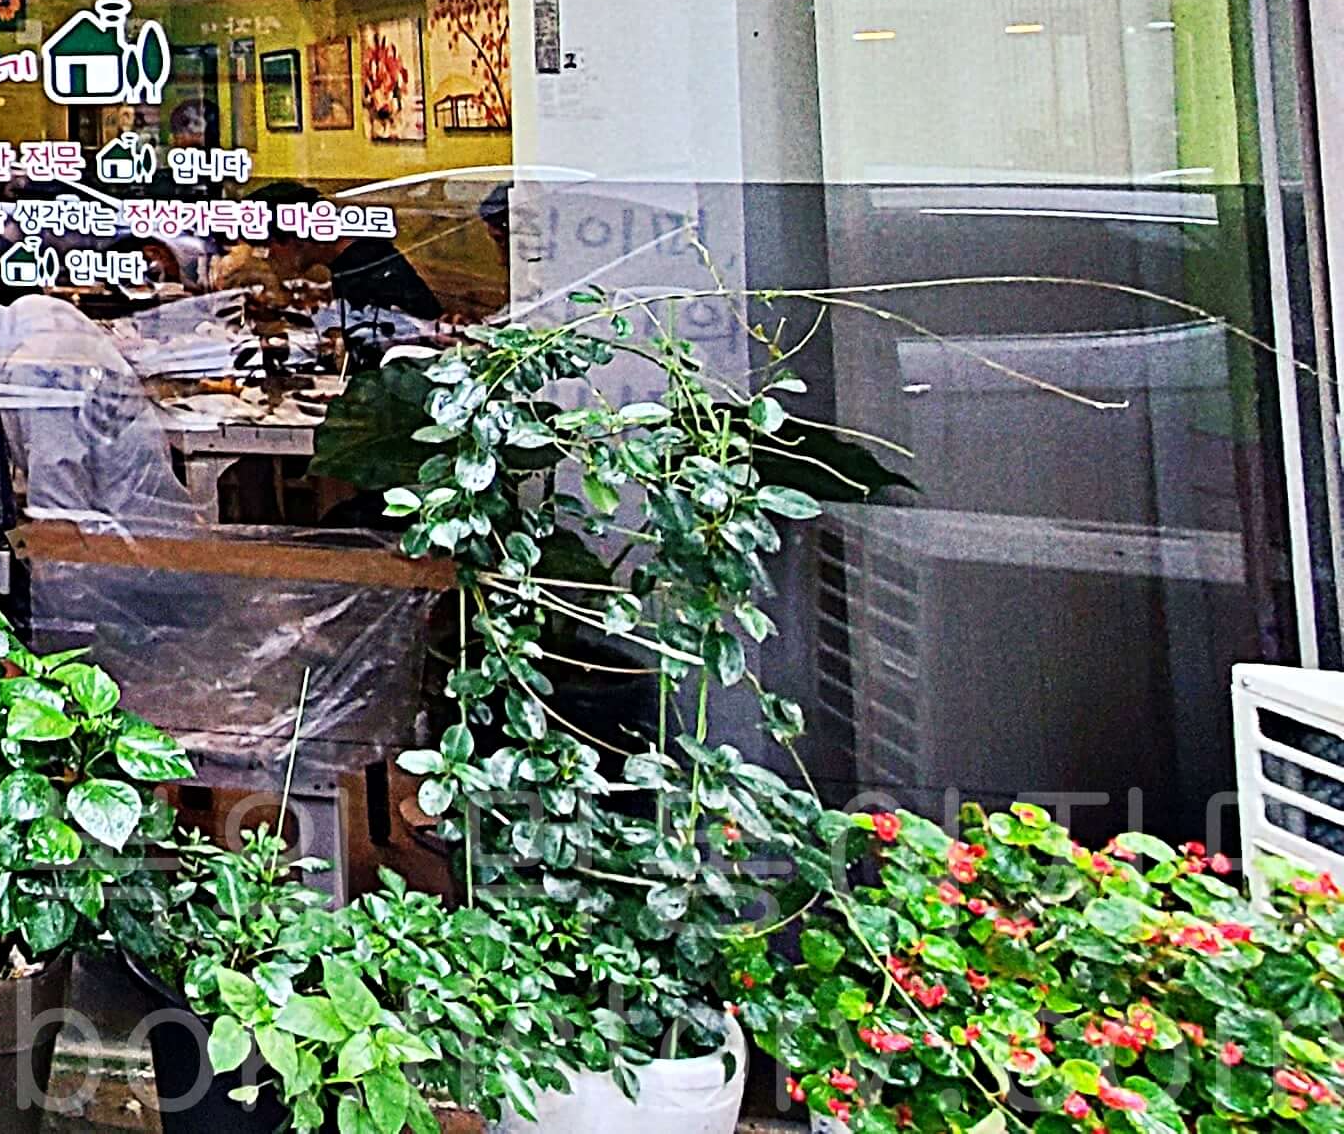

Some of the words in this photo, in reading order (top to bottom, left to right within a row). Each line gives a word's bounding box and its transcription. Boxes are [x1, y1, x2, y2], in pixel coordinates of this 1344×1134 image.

[23, 143, 83, 179] 전문
[171, 150, 250, 181] 입니다
[15, 201, 116, 234] 생각하는
[279, 205, 395, 238] 마음으로
[68, 252, 147, 283] 입니다
